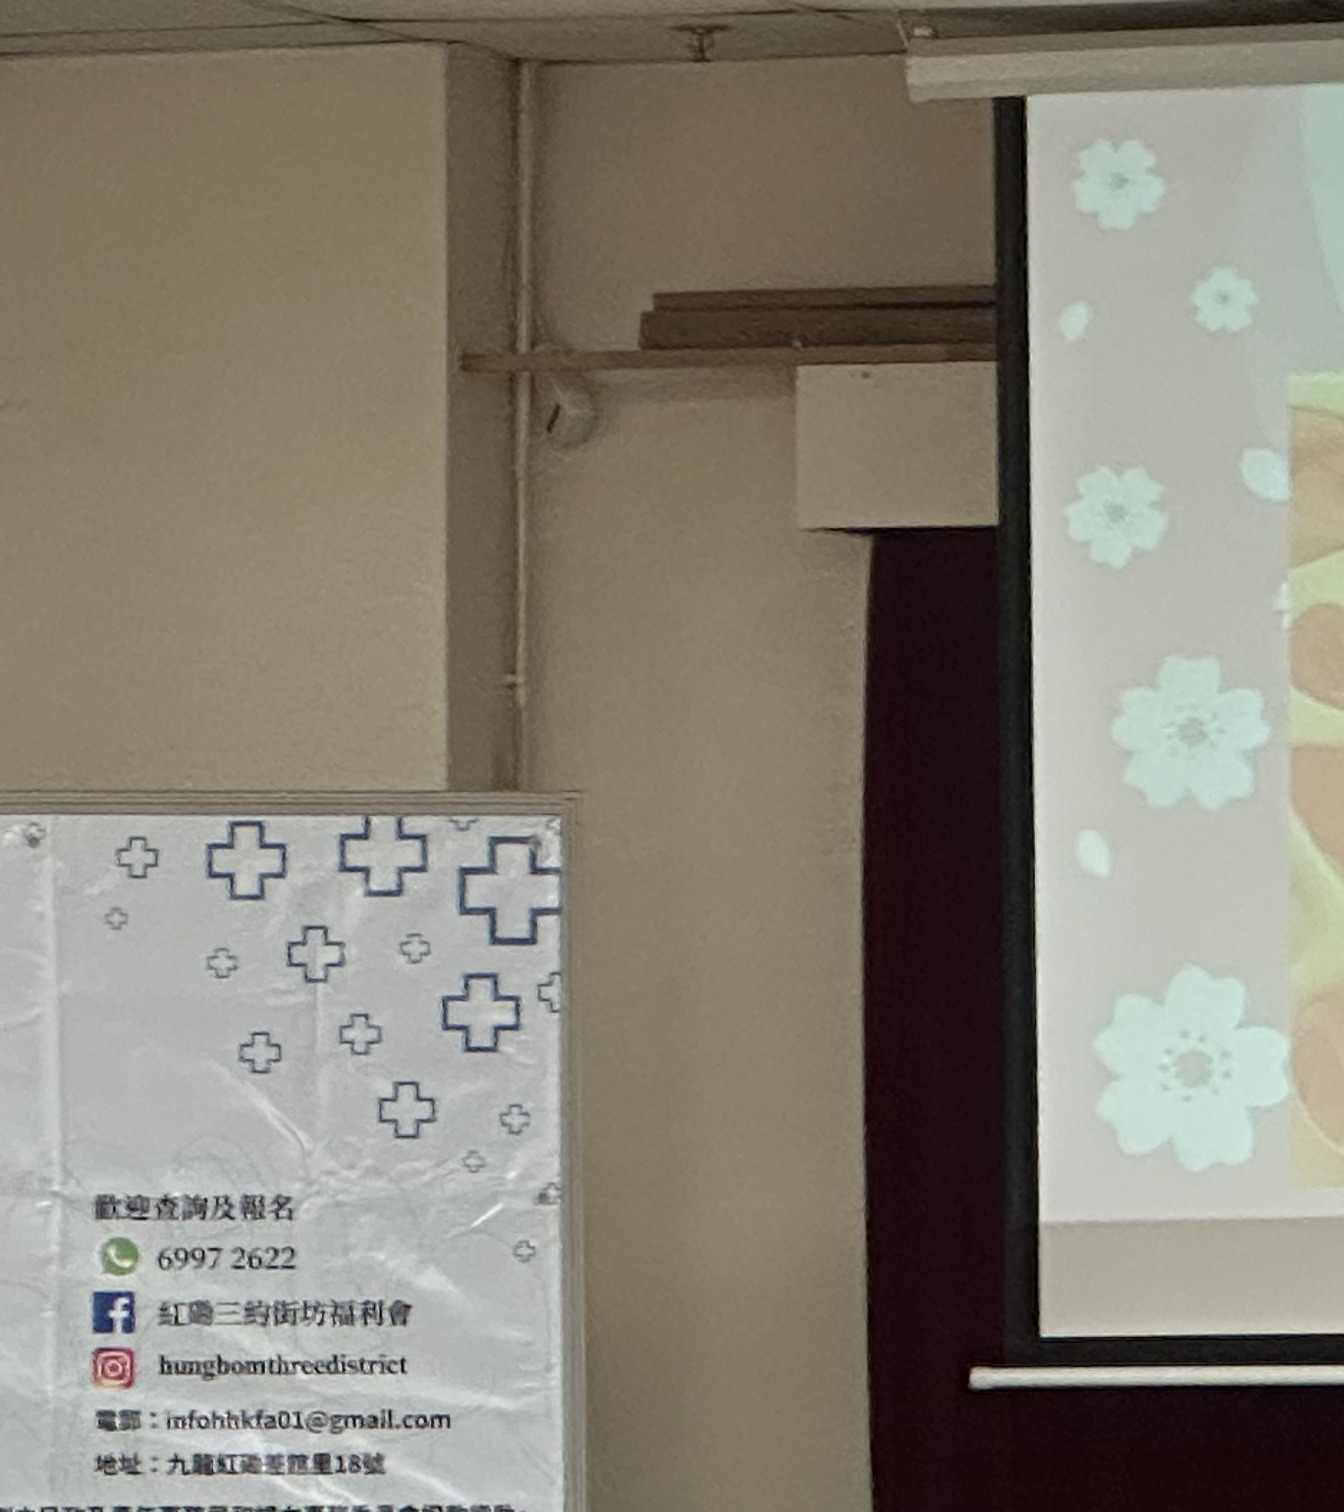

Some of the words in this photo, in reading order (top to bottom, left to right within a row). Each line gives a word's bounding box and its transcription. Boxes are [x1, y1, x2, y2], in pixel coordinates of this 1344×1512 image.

[94, 1193, 294, 1222] 歡迎查詢及報名
[157, 1246, 223, 1271] 6997
[229, 1246, 297, 1271] 2622
